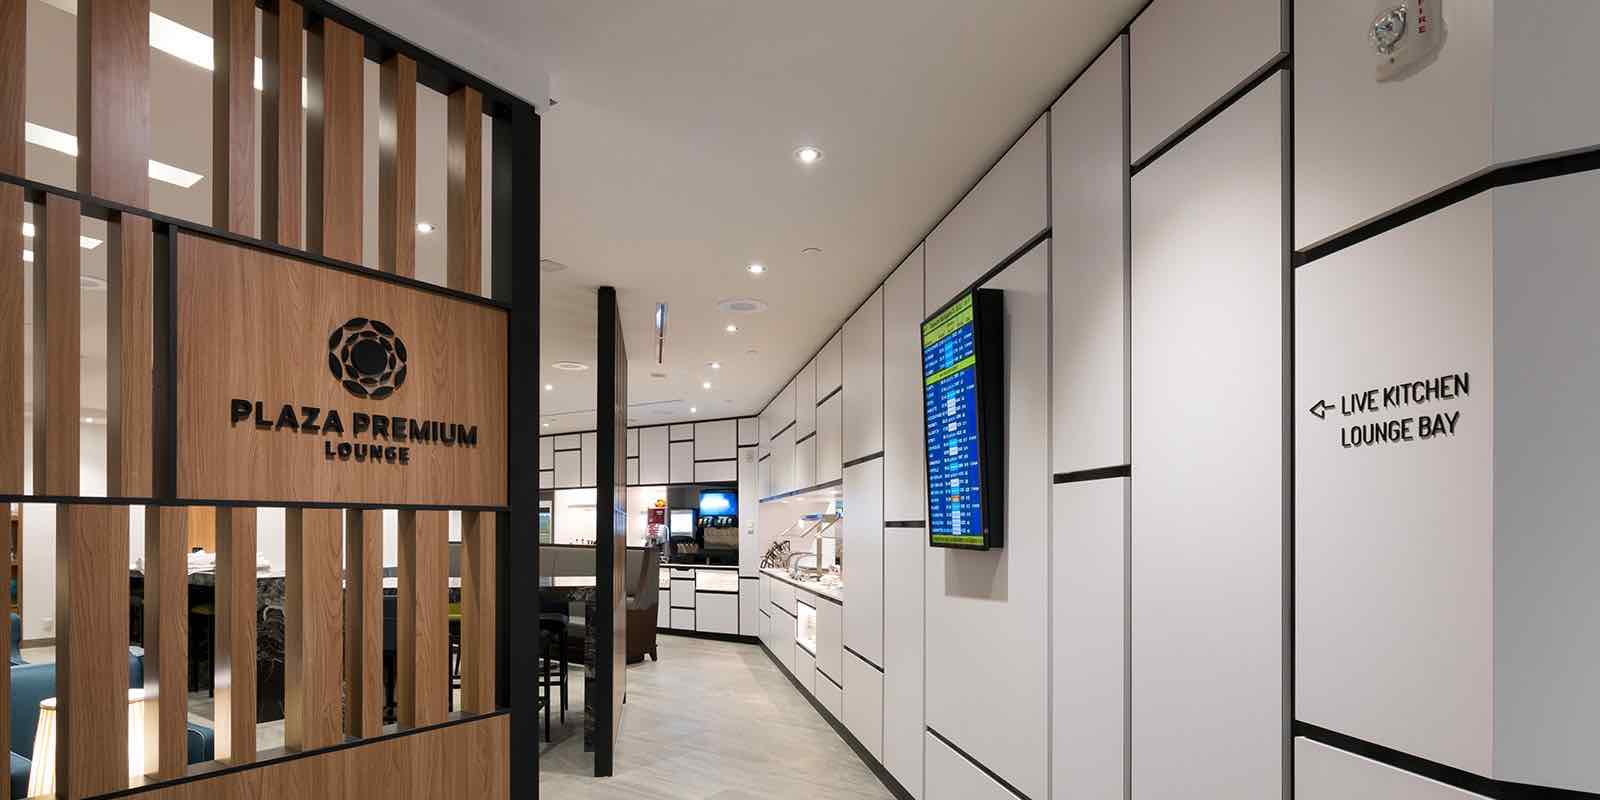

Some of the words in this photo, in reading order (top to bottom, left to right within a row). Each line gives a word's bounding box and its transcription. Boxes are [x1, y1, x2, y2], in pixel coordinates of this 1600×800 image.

[1341, 389, 1379, 416] LIVE
[1383, 372, 1470, 408] KITCHEN
[230, 398, 344, 438] PLAZA
[352, 412, 478, 448] PREMIUM
[1341, 418, 1414, 448] LOUNGE
[1418, 411, 1460, 441] BAY
[324, 440, 410, 465] LOUNGE
